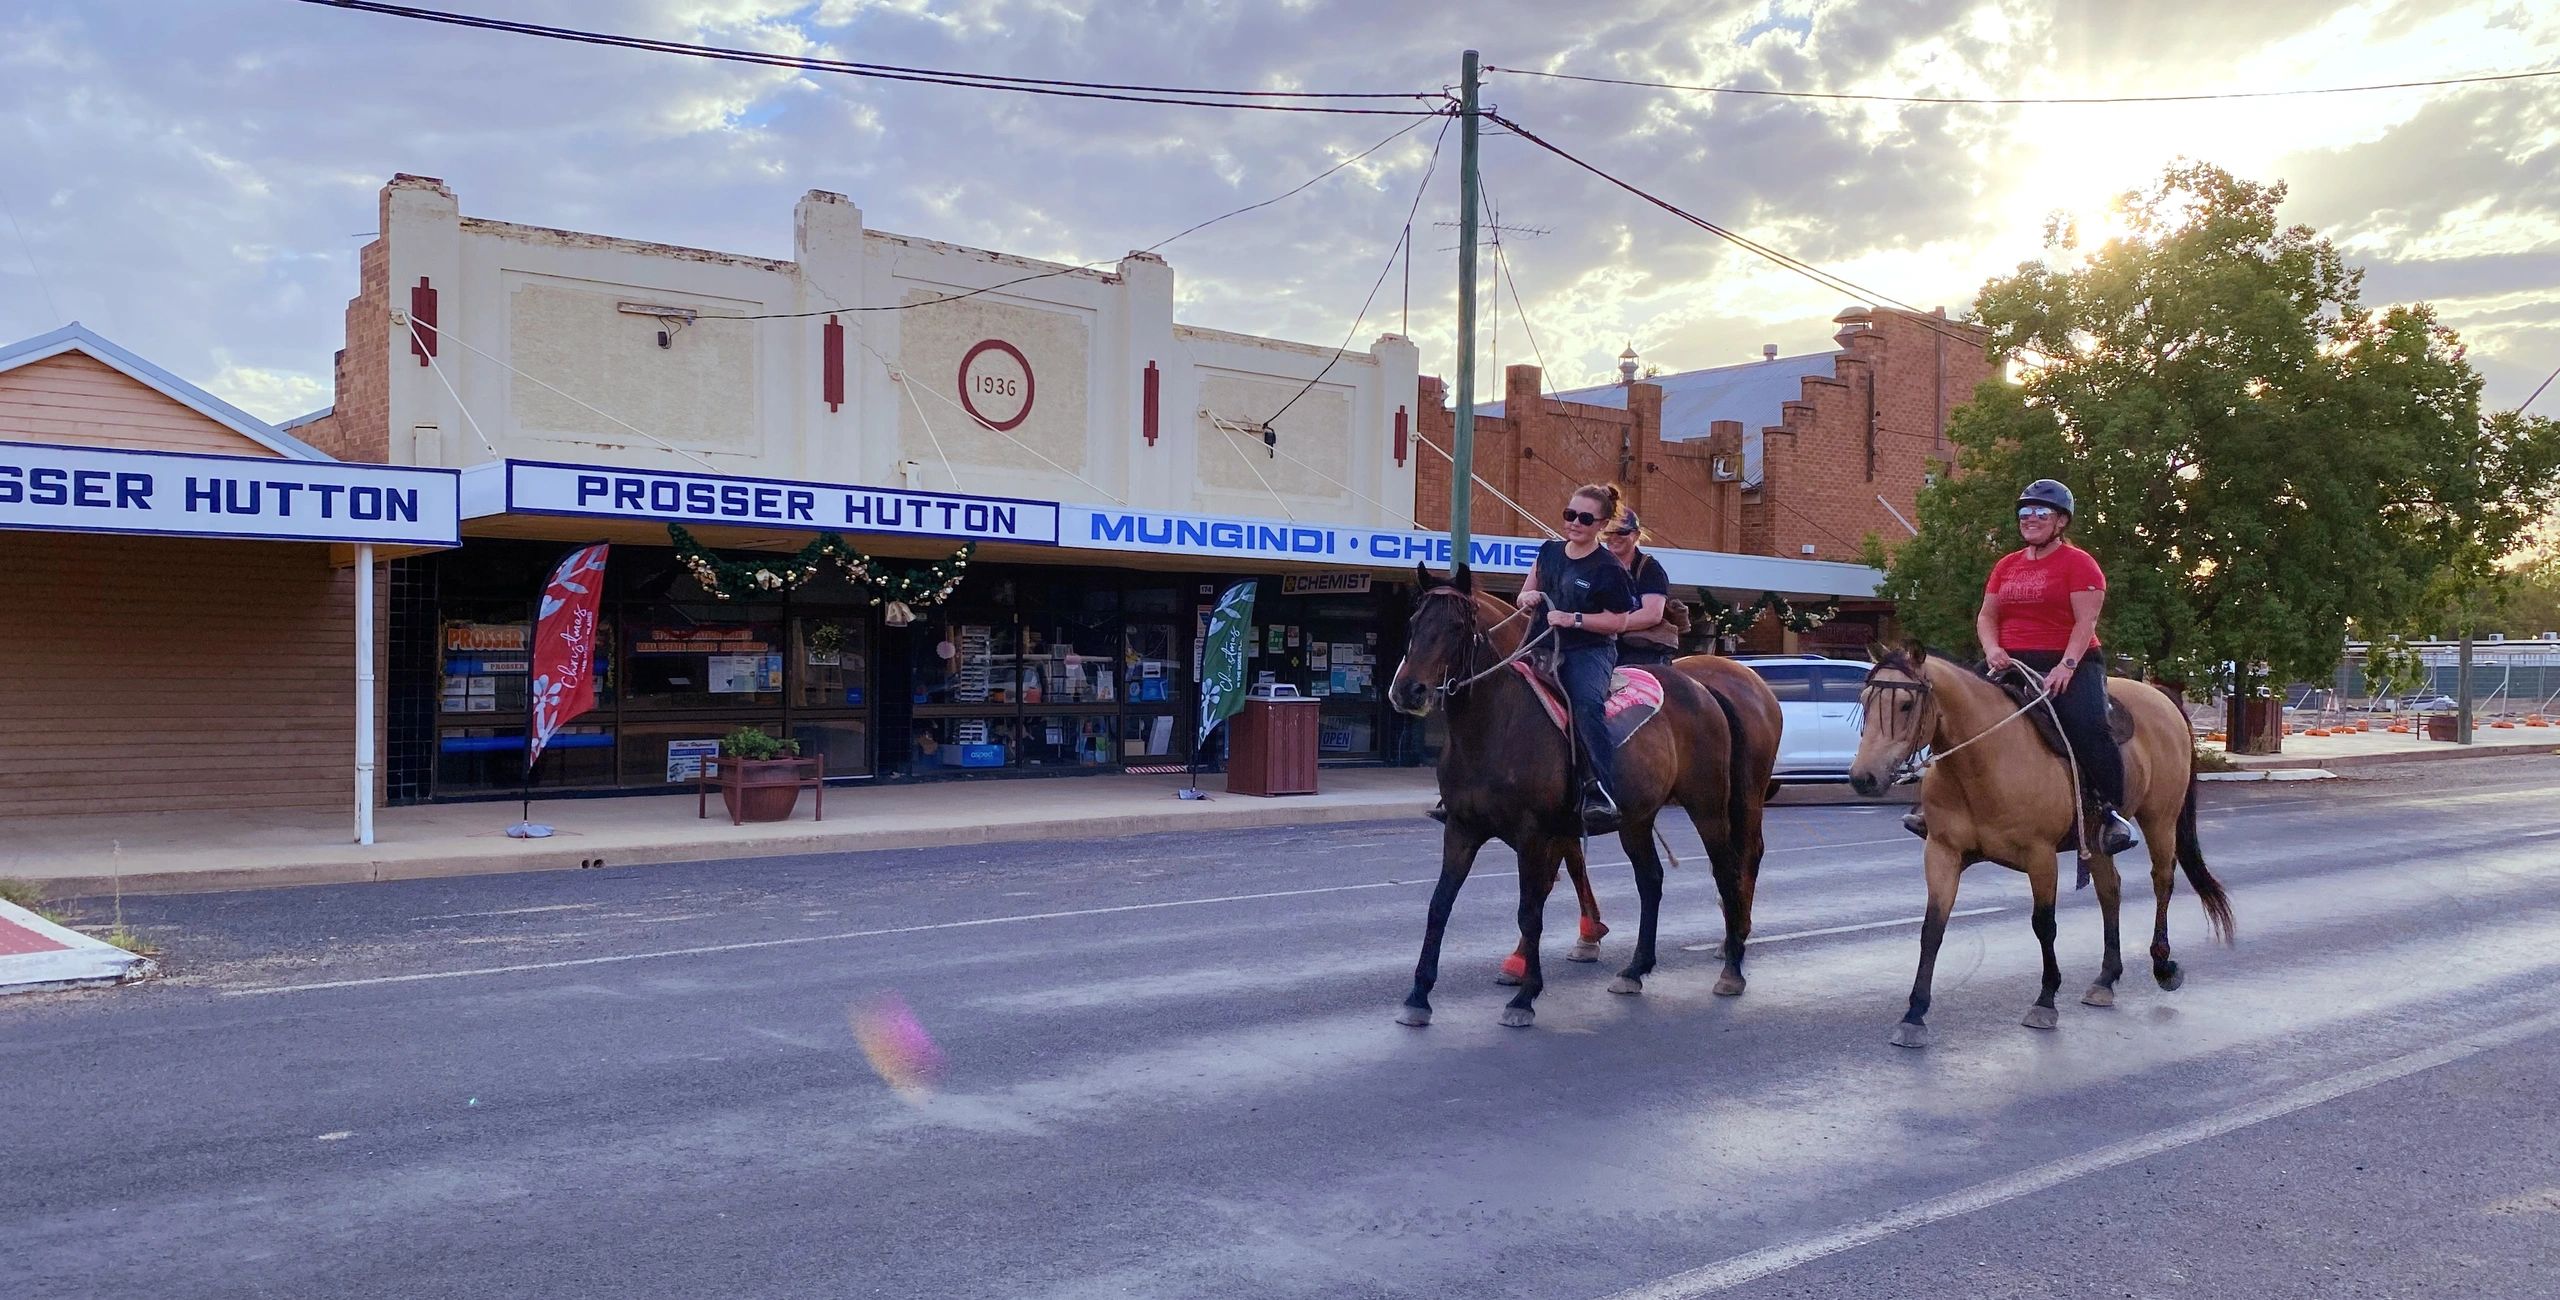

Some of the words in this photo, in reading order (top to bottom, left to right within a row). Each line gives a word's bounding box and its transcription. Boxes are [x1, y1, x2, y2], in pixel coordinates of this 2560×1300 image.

[976, 375, 1016, 397] 1936
[185, 476, 418, 522] HUTTON
[577, 474, 814, 521] PROSSER
[845, 494, 1016, 534] HUTTON
[1091, 513, 1335, 554] MUNGINDI
[1370, 534, 1541, 567] CHEMIS
[1296, 573, 1370, 590] CHEMIST
[447, 628, 526, 650] PROSSER
[556, 603, 587, 689] Christmas
[1322, 732, 1350, 745] OPEN
